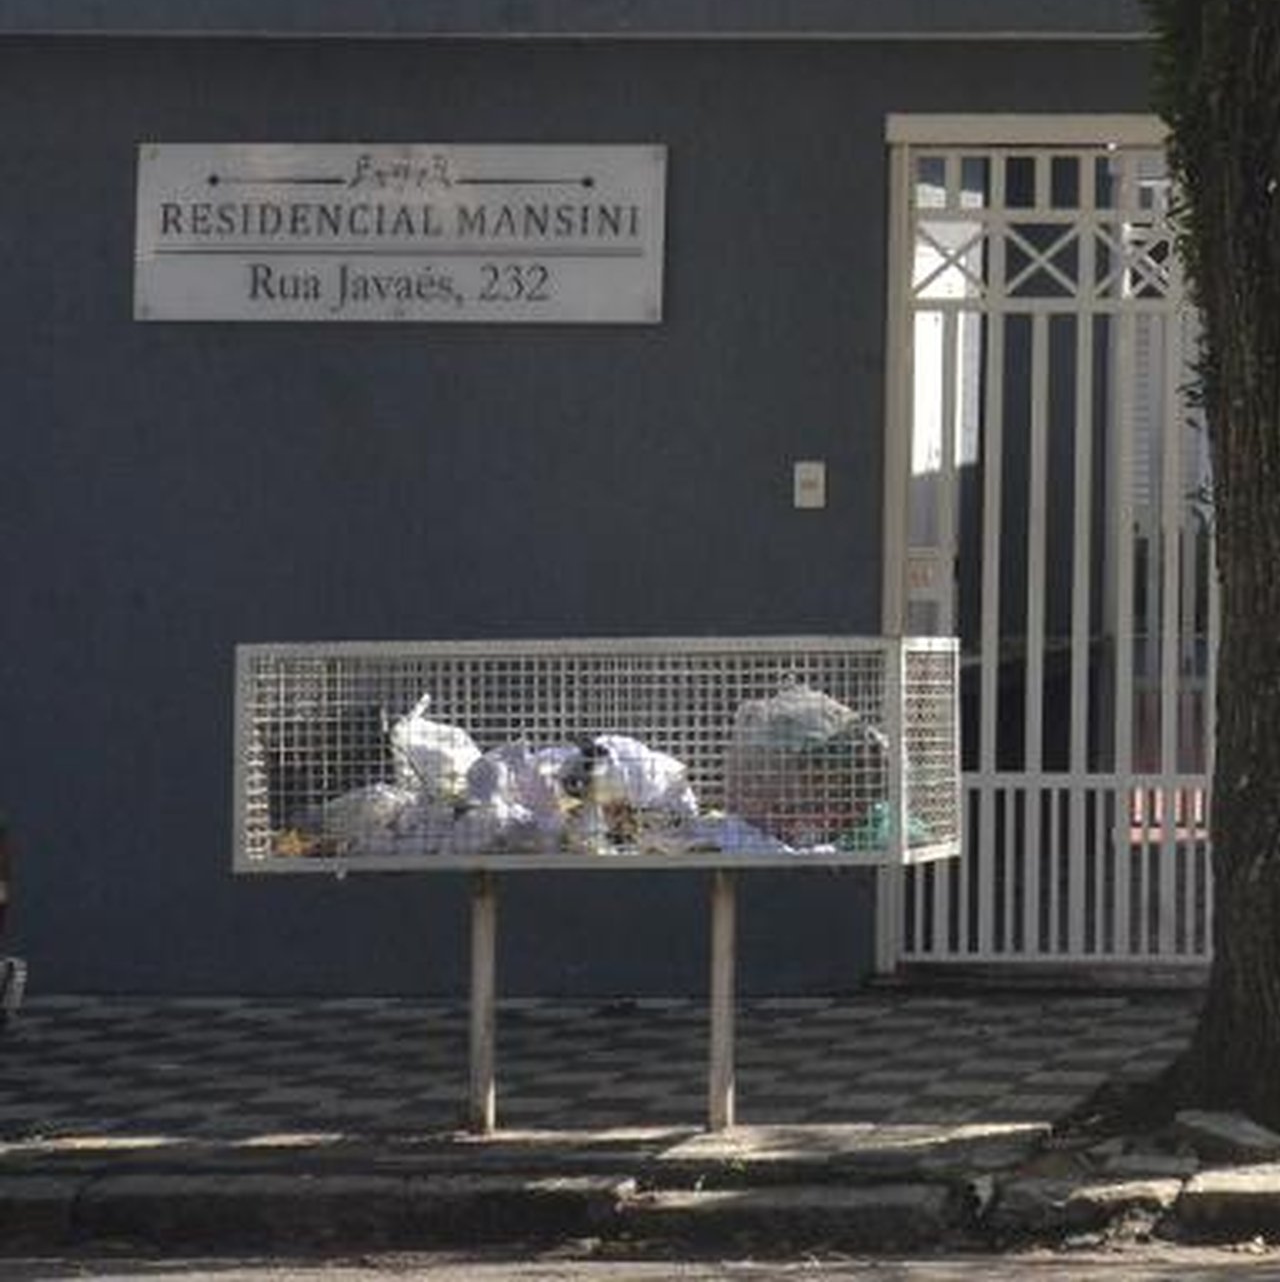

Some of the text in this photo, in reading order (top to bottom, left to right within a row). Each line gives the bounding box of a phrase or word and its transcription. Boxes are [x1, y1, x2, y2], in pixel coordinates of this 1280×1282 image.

[160, 202, 641, 238] RESIDENCIAL MANSINI
[248, 262, 321, 301] Rua
[479, 263, 550, 302] 232
